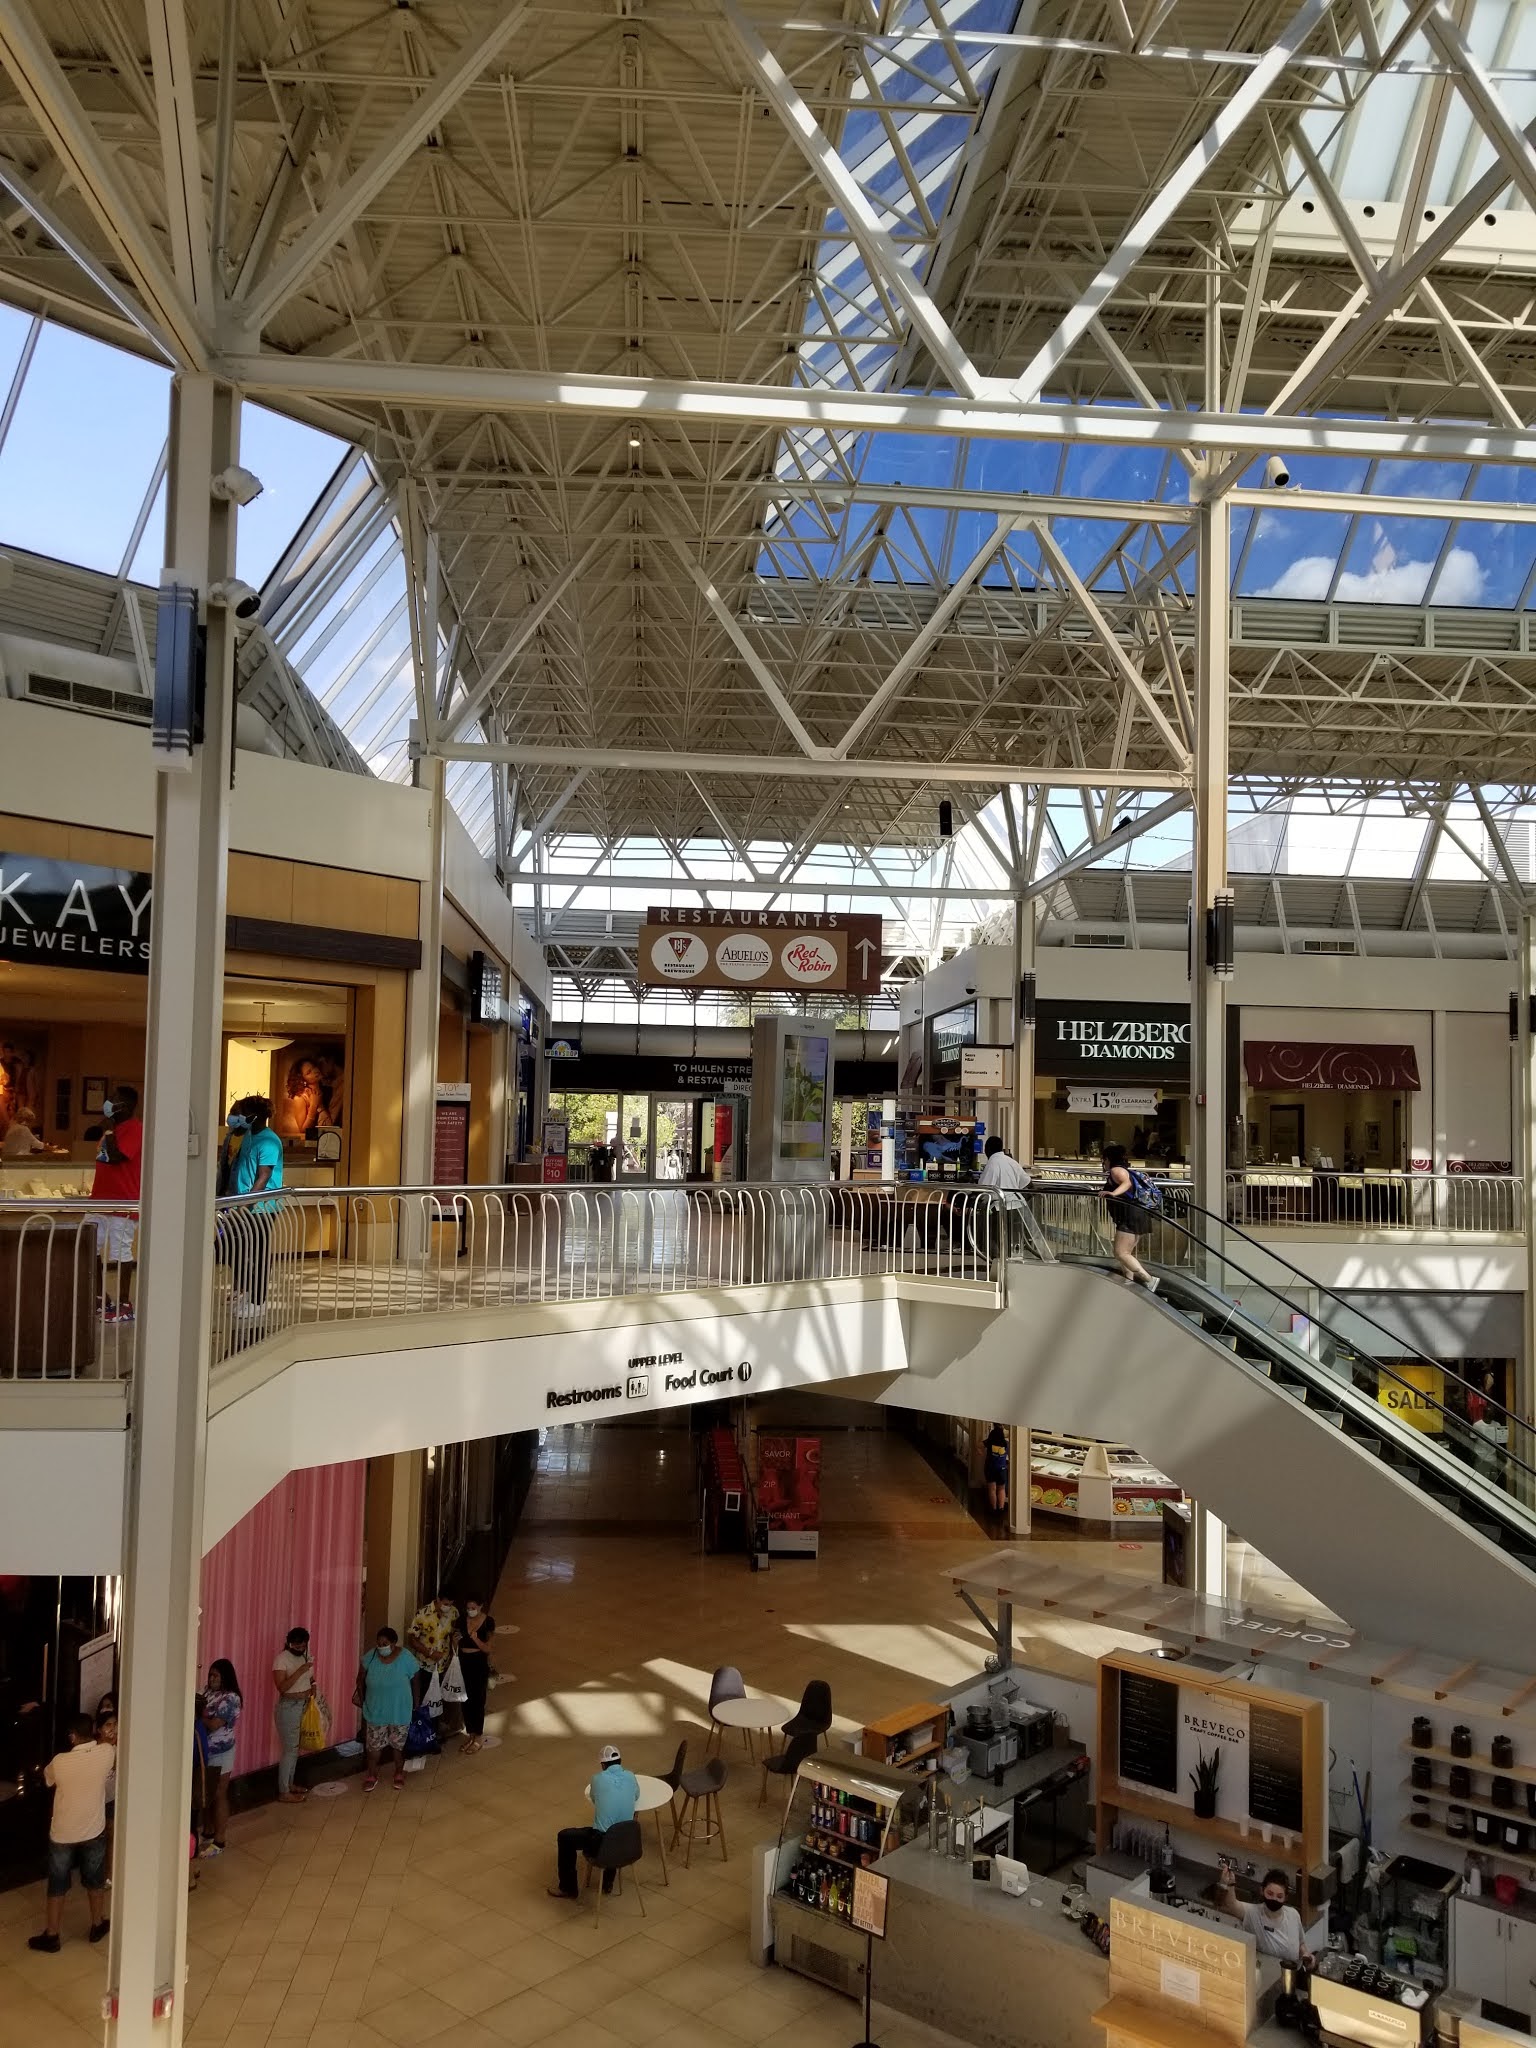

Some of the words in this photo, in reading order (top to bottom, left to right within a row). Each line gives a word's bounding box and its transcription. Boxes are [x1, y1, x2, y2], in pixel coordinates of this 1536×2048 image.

[0, 868, 152, 937] KAY
[660, 908, 838, 928] RESTAURANTS
[0, 926, 151, 960] JEWELERS
[721, 946, 769, 961] ABUELO'S
[793, 944, 819, 960] Red
[798, 957, 832, 973] Robin
[1080, 1043, 1175, 1060] DIAMONDS
[673, 1064, 688, 1072] TO
[690, 1065, 724, 1073] HULEN
[727, 1065, 752, 1074] STRE
[677, 1075, 685, 1084] &
[687, 1076, 752, 1085] RESTAURANT
[546, 1169, 560, 1178] $10
[628, 1355, 656, 1369] UPPER
[658, 1352, 684, 1366] LEVEL
[665, 1370, 697, 1393] Food
[699, 1366, 734, 1386] Court
[546, 1384, 623, 1409] Restrooms
[1387, 1390, 1436, 1410] SALE
[764, 1450, 791, 1458] SAVOR
[763, 1480, 776, 1488] ZIP
[768, 1511, 801, 1519] NCHANT
[1222, 1616, 1351, 1648] COFFEE
[1184, 1714, 1245, 1739] BREVECO
[1115, 1909, 1241, 1968] BREVECO
